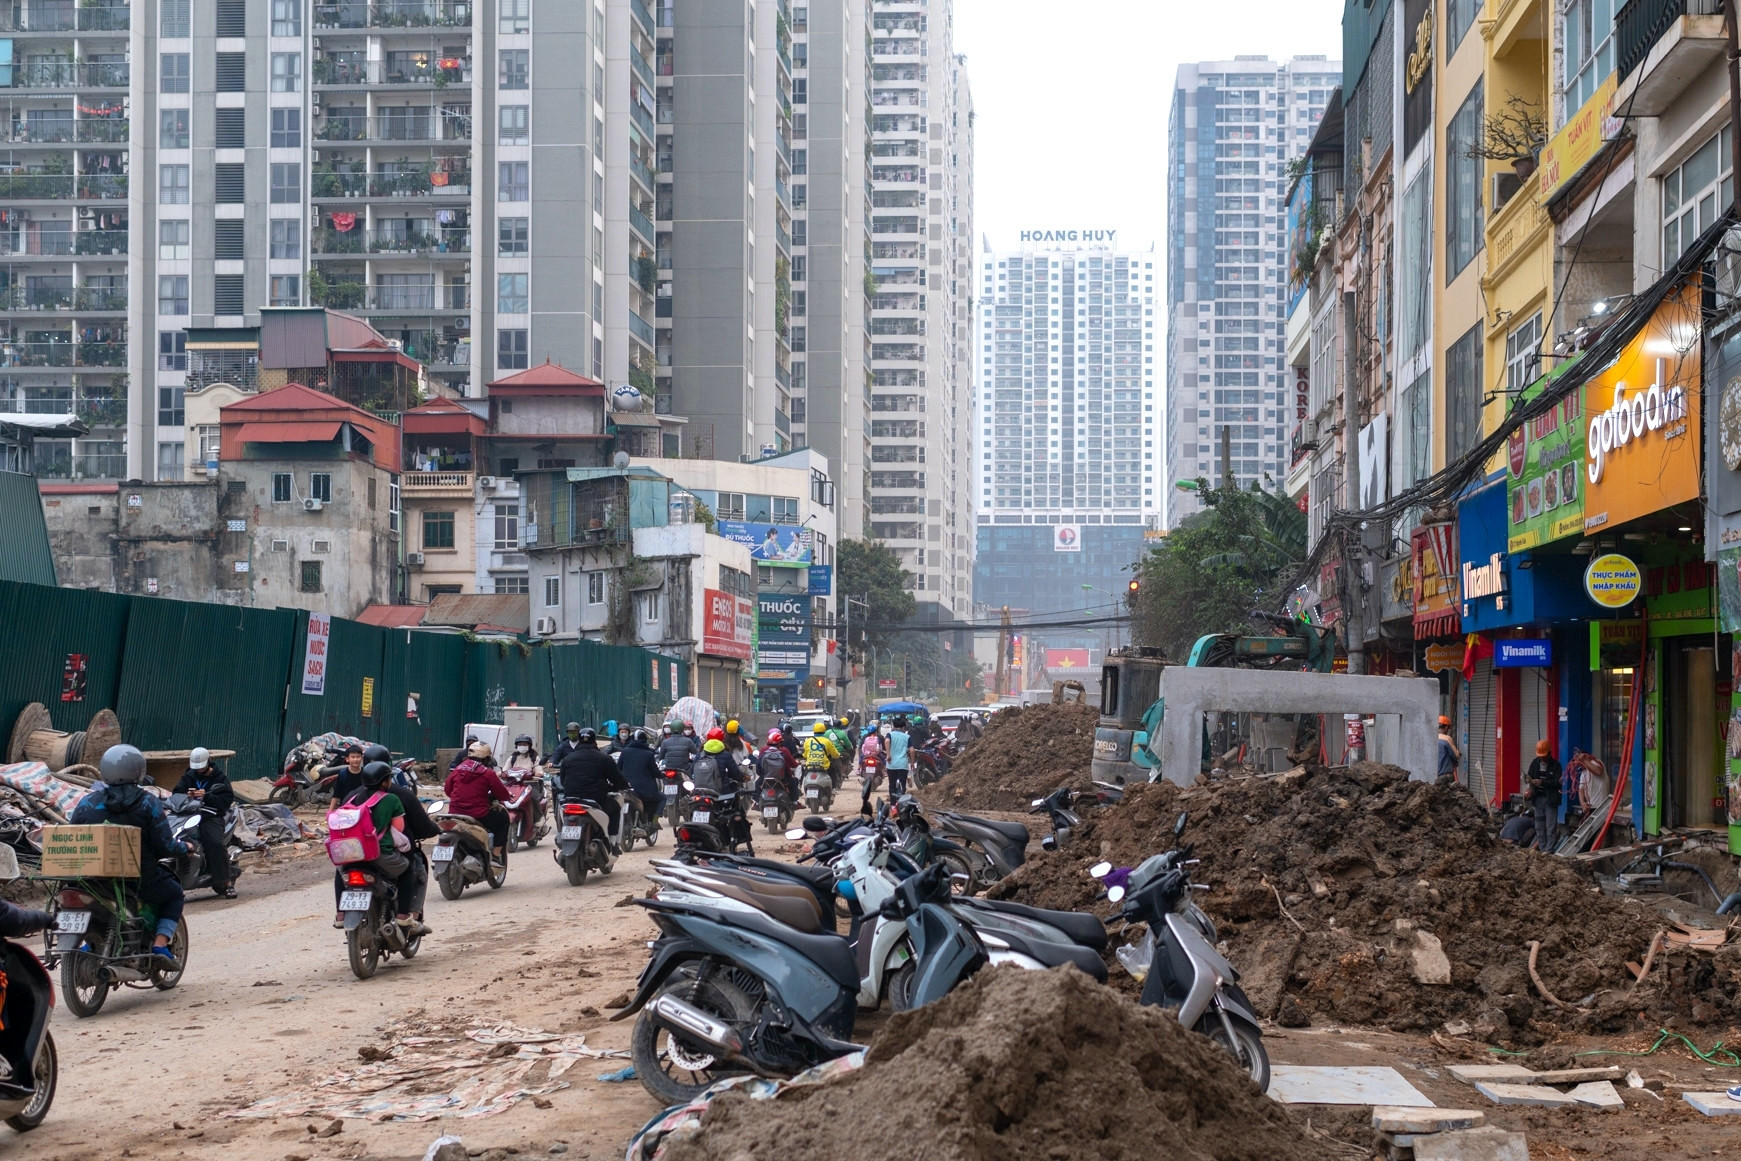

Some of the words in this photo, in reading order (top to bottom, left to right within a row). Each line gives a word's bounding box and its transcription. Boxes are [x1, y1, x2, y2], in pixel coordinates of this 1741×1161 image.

[1020, 230, 1078, 241] HOANG
[1083, 230, 1116, 241] HUY
[1296, 367, 1309, 420] KORE
[1463, 551, 1503, 601] Vinamilk
[1592, 571, 1613, 581] THỰC
[1614, 569, 1636, 578] PHẨM
[1593, 583, 1614, 592] NHẬP
[713, 596, 732, 618] ENEOS
[760, 599, 801, 614] THUỐC
[322, 622, 329, 637] XE
[1502, 645, 1546, 656] Vinamilk
[1095, 740, 1117, 752] OBELCO
[52, 834, 73, 843] NGỌC
[75, 833, 94, 842] LINH
[47, 844, 77, 854] TRƯỜNG
[80, 846, 98, 854] SINH
[342, 900, 368, 909] 749.33
